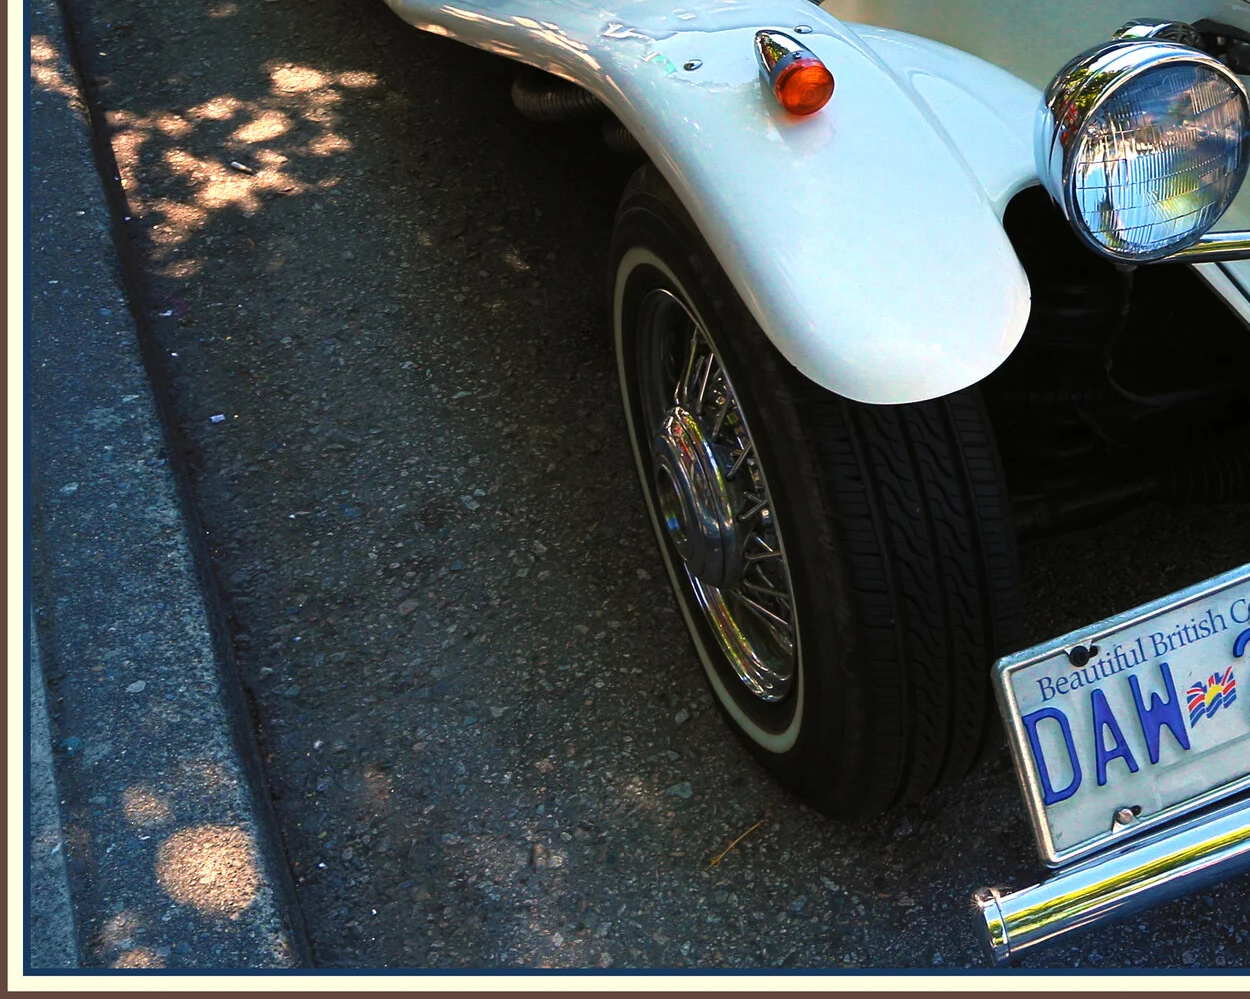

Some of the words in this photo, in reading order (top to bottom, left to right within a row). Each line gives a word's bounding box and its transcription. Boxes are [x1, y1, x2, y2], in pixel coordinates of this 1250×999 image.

[1037, 637, 1146, 703] Beautiful
[1153, 612, 1228, 658] British
[1022, 661, 1191, 805] DAW
